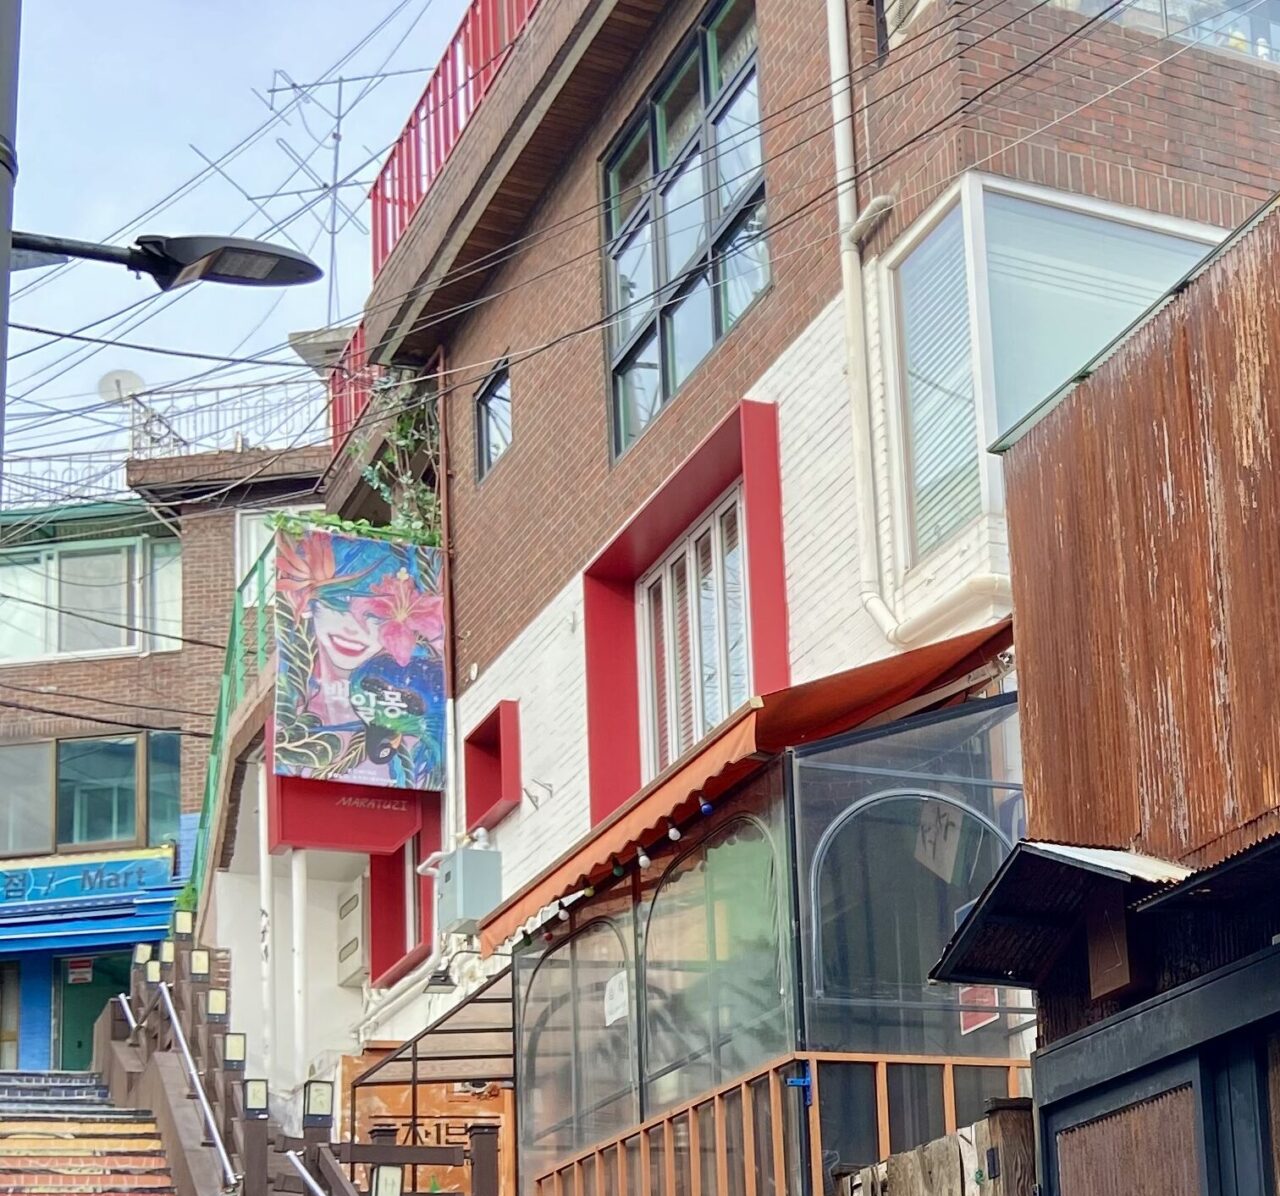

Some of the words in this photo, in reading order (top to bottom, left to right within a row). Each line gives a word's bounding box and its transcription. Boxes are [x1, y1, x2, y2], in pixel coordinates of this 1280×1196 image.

[324, 679, 408, 725] 백일몽
[335, 796, 408, 812] MARATUZI
[81, 866, 147, 891] Mart
